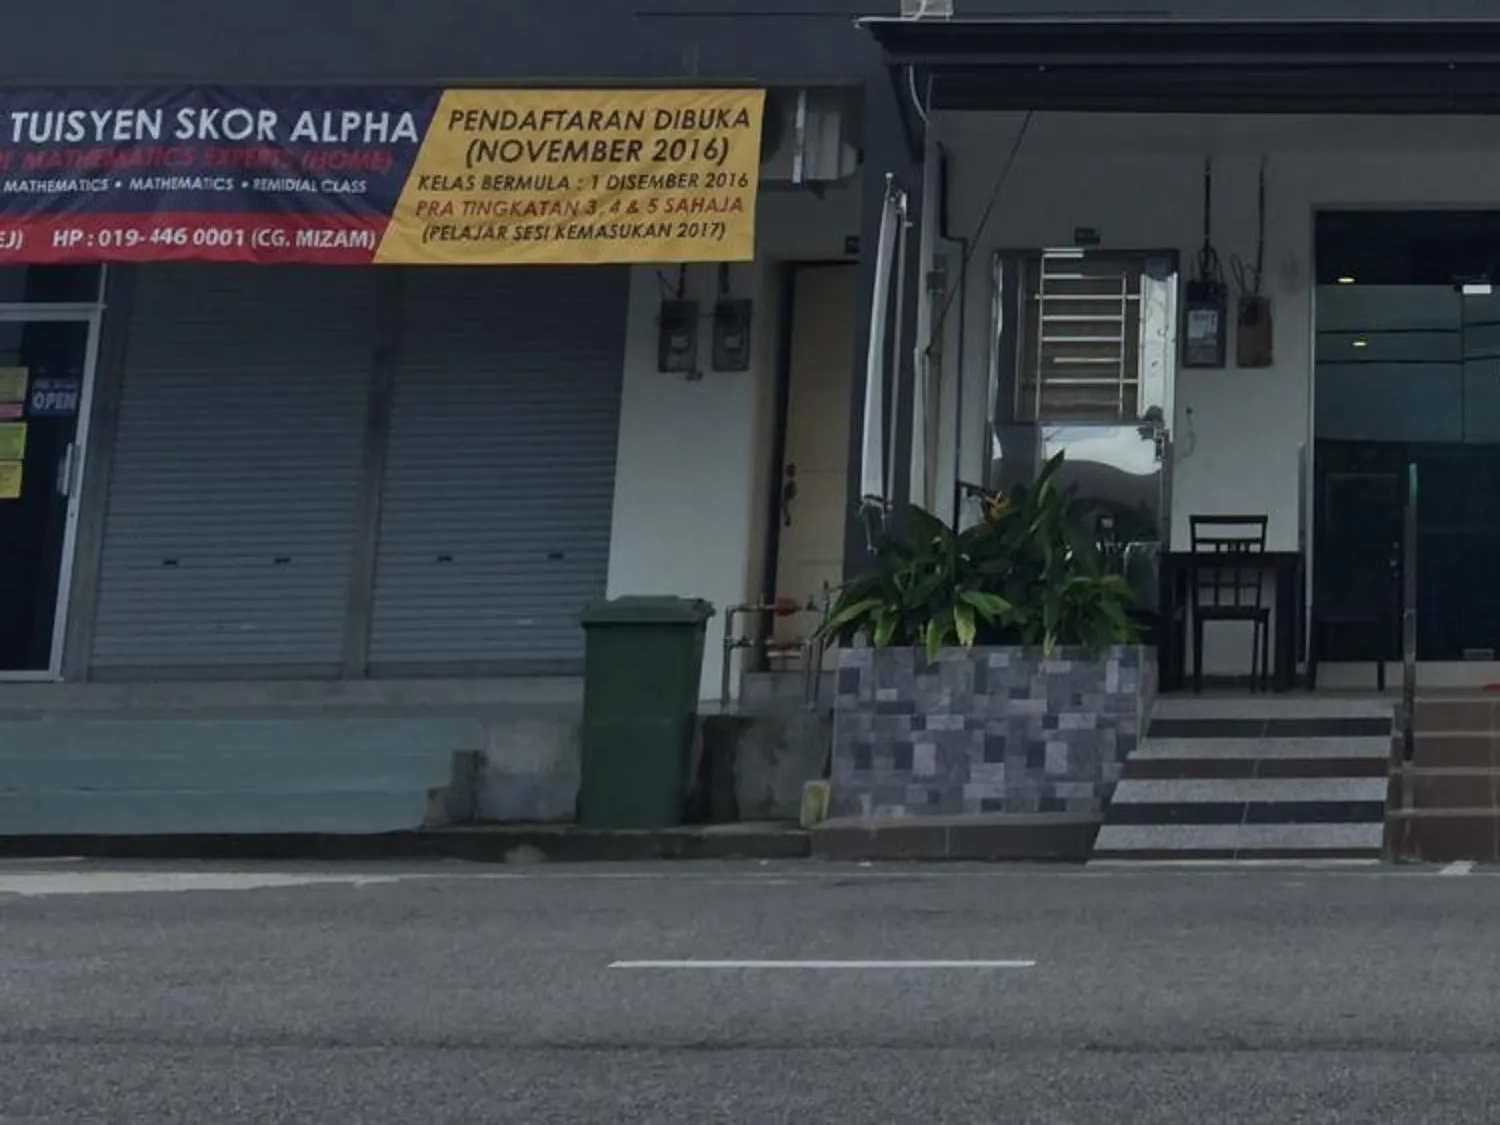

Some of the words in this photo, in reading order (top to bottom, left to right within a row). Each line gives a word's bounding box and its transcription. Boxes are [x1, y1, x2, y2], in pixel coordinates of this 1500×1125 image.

[11, 109, 163, 143] TUISYEN
[175, 108, 278, 141] SKOR
[290, 110, 419, 143] ALPHA
[449, 109, 645, 132] PENDAFTARAN
[654, 107, 750, 130] DIBUKA
[466, 139, 643, 168] (NOVEMBER
[652, 138, 729, 166] 2016)
[3, 178, 109, 194] MATHEMATICS
[129, 177, 234, 192] MATHEMATICS
[253, 178, 317, 193] REMIDIAL
[321, 178, 367, 193] CLASS
[418, 175, 475, 192] KELAS
[481, 175, 570, 192] BERMULA
[591, 174, 598, 190] 1
[607, 173, 699, 191] DISEMBER
[705, 172, 749, 189] 2016
[415, 200, 455, 217] PRA
[463, 200, 579, 217] TINGKATAN
[626, 199, 640, 214] &
[648, 198, 659, 214] 5
[664, 197, 744, 213] SAHAJA
[52, 230, 83, 247] HP
[193, 229, 244, 247] 0001
[296, 229, 375, 250] MIZAM)
[422, 223, 507, 243] (PELAJAR
[512, 223, 550, 240] SESI
[554, 222, 673, 240] KEMASUKAN
[676, 222, 726, 242] 2017)
[32, 390, 77, 410] OPEN
